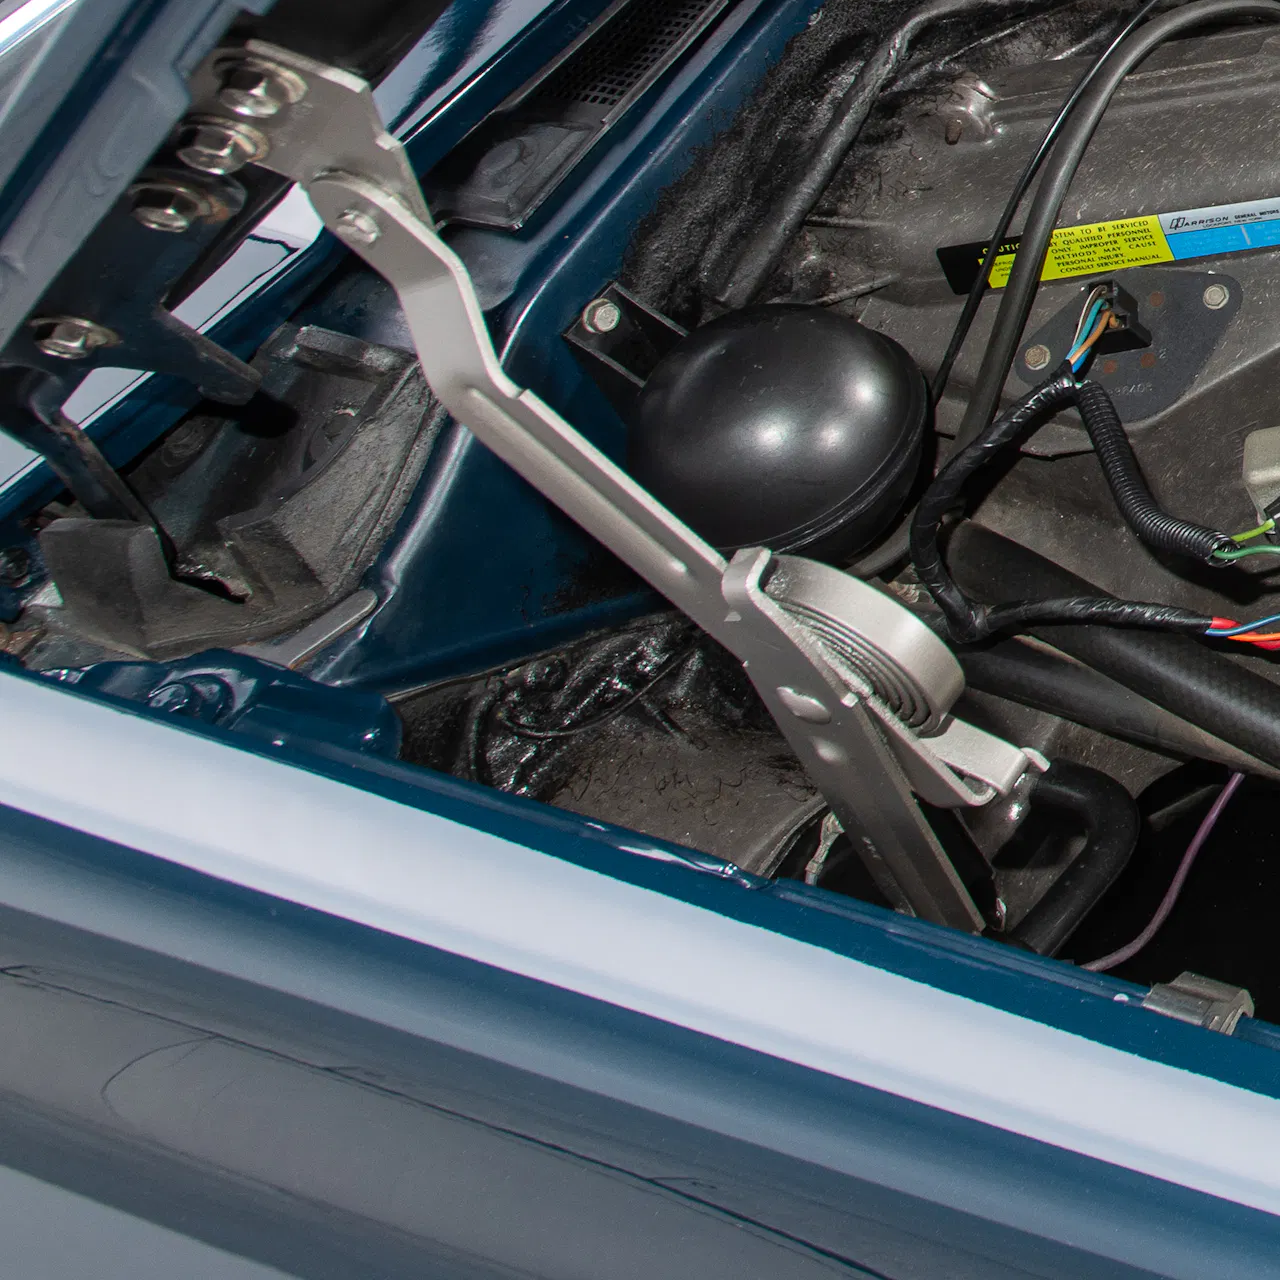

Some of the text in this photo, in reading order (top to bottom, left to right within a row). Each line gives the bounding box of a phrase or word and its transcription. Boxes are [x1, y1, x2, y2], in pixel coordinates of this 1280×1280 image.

[1111, 219, 1149, 230] SERVICED
[1061, 227, 1151, 245] QUALIFIED PERSONNEL
[1078, 239, 1118, 249] IMPROPER
[1123, 233, 1154, 243] SERVICE
[1053, 249, 1097, 261] METHODS
[1127, 240, 1157, 249] CAUSE
[1056, 256, 1096, 267] PERSONAL
[1059, 263, 1095, 273] CONSULT
[1095, 258, 1125, 267] SERVICE
